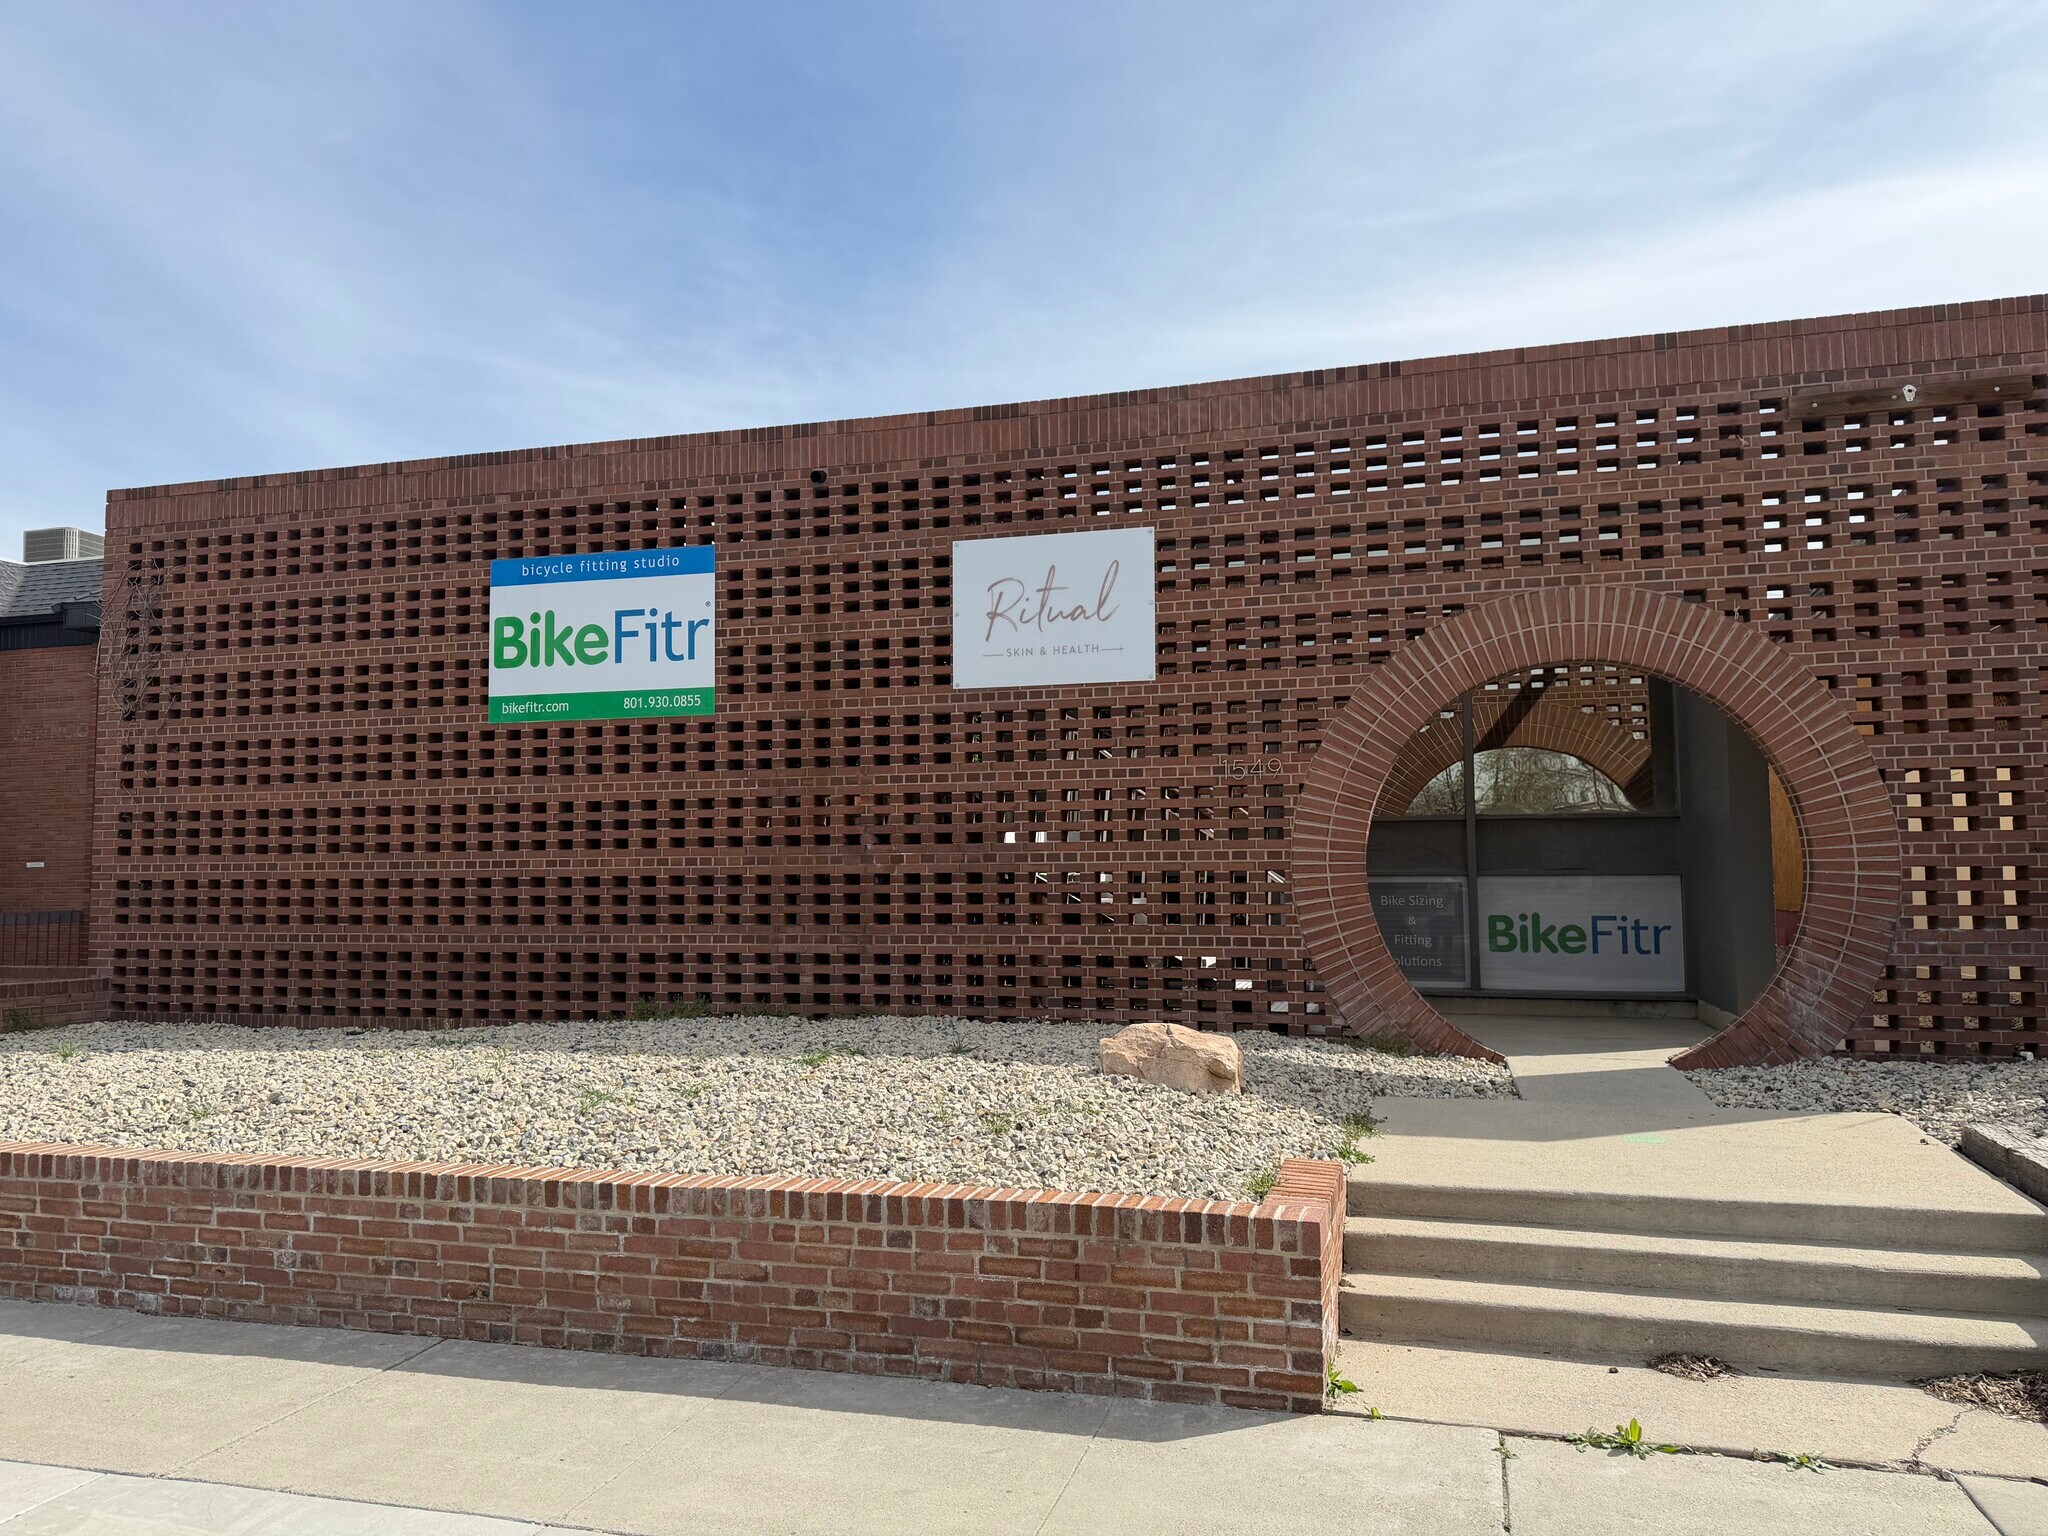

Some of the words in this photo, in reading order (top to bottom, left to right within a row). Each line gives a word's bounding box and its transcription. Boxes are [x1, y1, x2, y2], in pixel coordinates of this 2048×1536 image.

[522, 562, 573, 577] bicycle
[580, 558, 627, 572] fitting
[634, 555, 679, 569] studio
[986, 560, 1120, 642] Ritual
[1006, 648, 1033, 657] SKIN
[1040, 647, 1046, 656] &
[1053, 644, 1099, 655] HEALTH
[502, 702, 569, 714] bikefitr.com
[623, 695, 700, 709] 801.930.0855
[1223, 758, 1281, 780] 1549
[1381, 896, 1405, 906] Bike
[1409, 896, 1443, 908] Sizing
[1408, 916, 1416, 925] &
[1488, 912, 1671, 955] BikeFitr
[1395, 935, 1432, 947] Fitting
[1394, 955, 1442, 966] olutions
